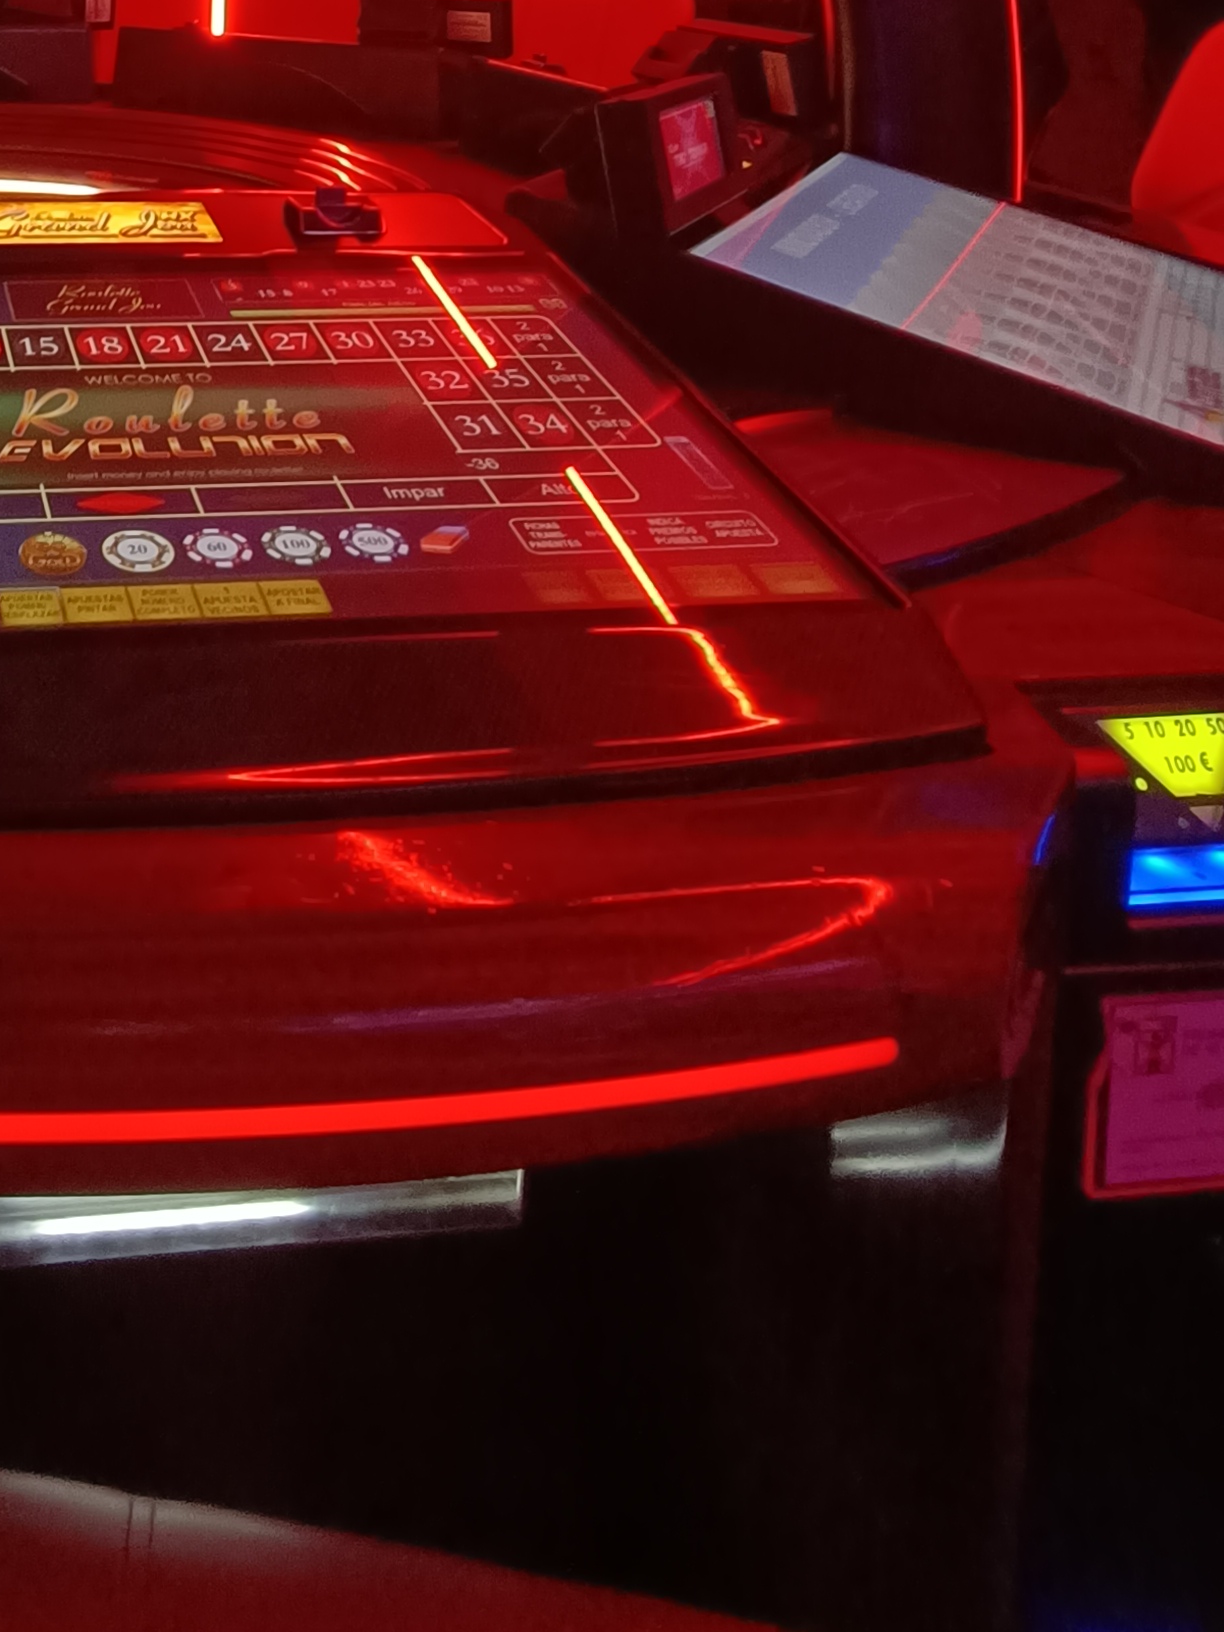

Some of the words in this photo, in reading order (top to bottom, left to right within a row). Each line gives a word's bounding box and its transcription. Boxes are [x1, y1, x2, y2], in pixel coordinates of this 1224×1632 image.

[19, 336, 59, 356] 15
[84, 336, 123, 355] 18
[147, 335, 188, 353] 21
[207, 334, 251, 352] 24
[270, 333, 309, 351] 27
[330, 332, 374, 349] 30
[392, 330, 435, 347] 33
[512, 331, 553, 343] para
[84, 373, 180, 385] WELCOME
[185, 373, 212, 384] TO
[420, 371, 469, 390] 32
[484, 369, 529, 387] 35
[547, 373, 591, 384] para
[11, 384, 321, 438] Roulette
[455, 415, 502, 436] 31
[519, 413, 568, 434] 34
[586, 417, 631, 430] para
[382, 483, 446, 501] Impar
[128, 543, 149, 555] 20
[281, 538, 311, 551] 100
[1123, 722, 1135, 740] 5
[1143, 721, 1166, 738] 10
[1174, 719, 1196, 737] 20
[1164, 754, 1196, 774] 100
[1199, 751, 1213, 772] €
